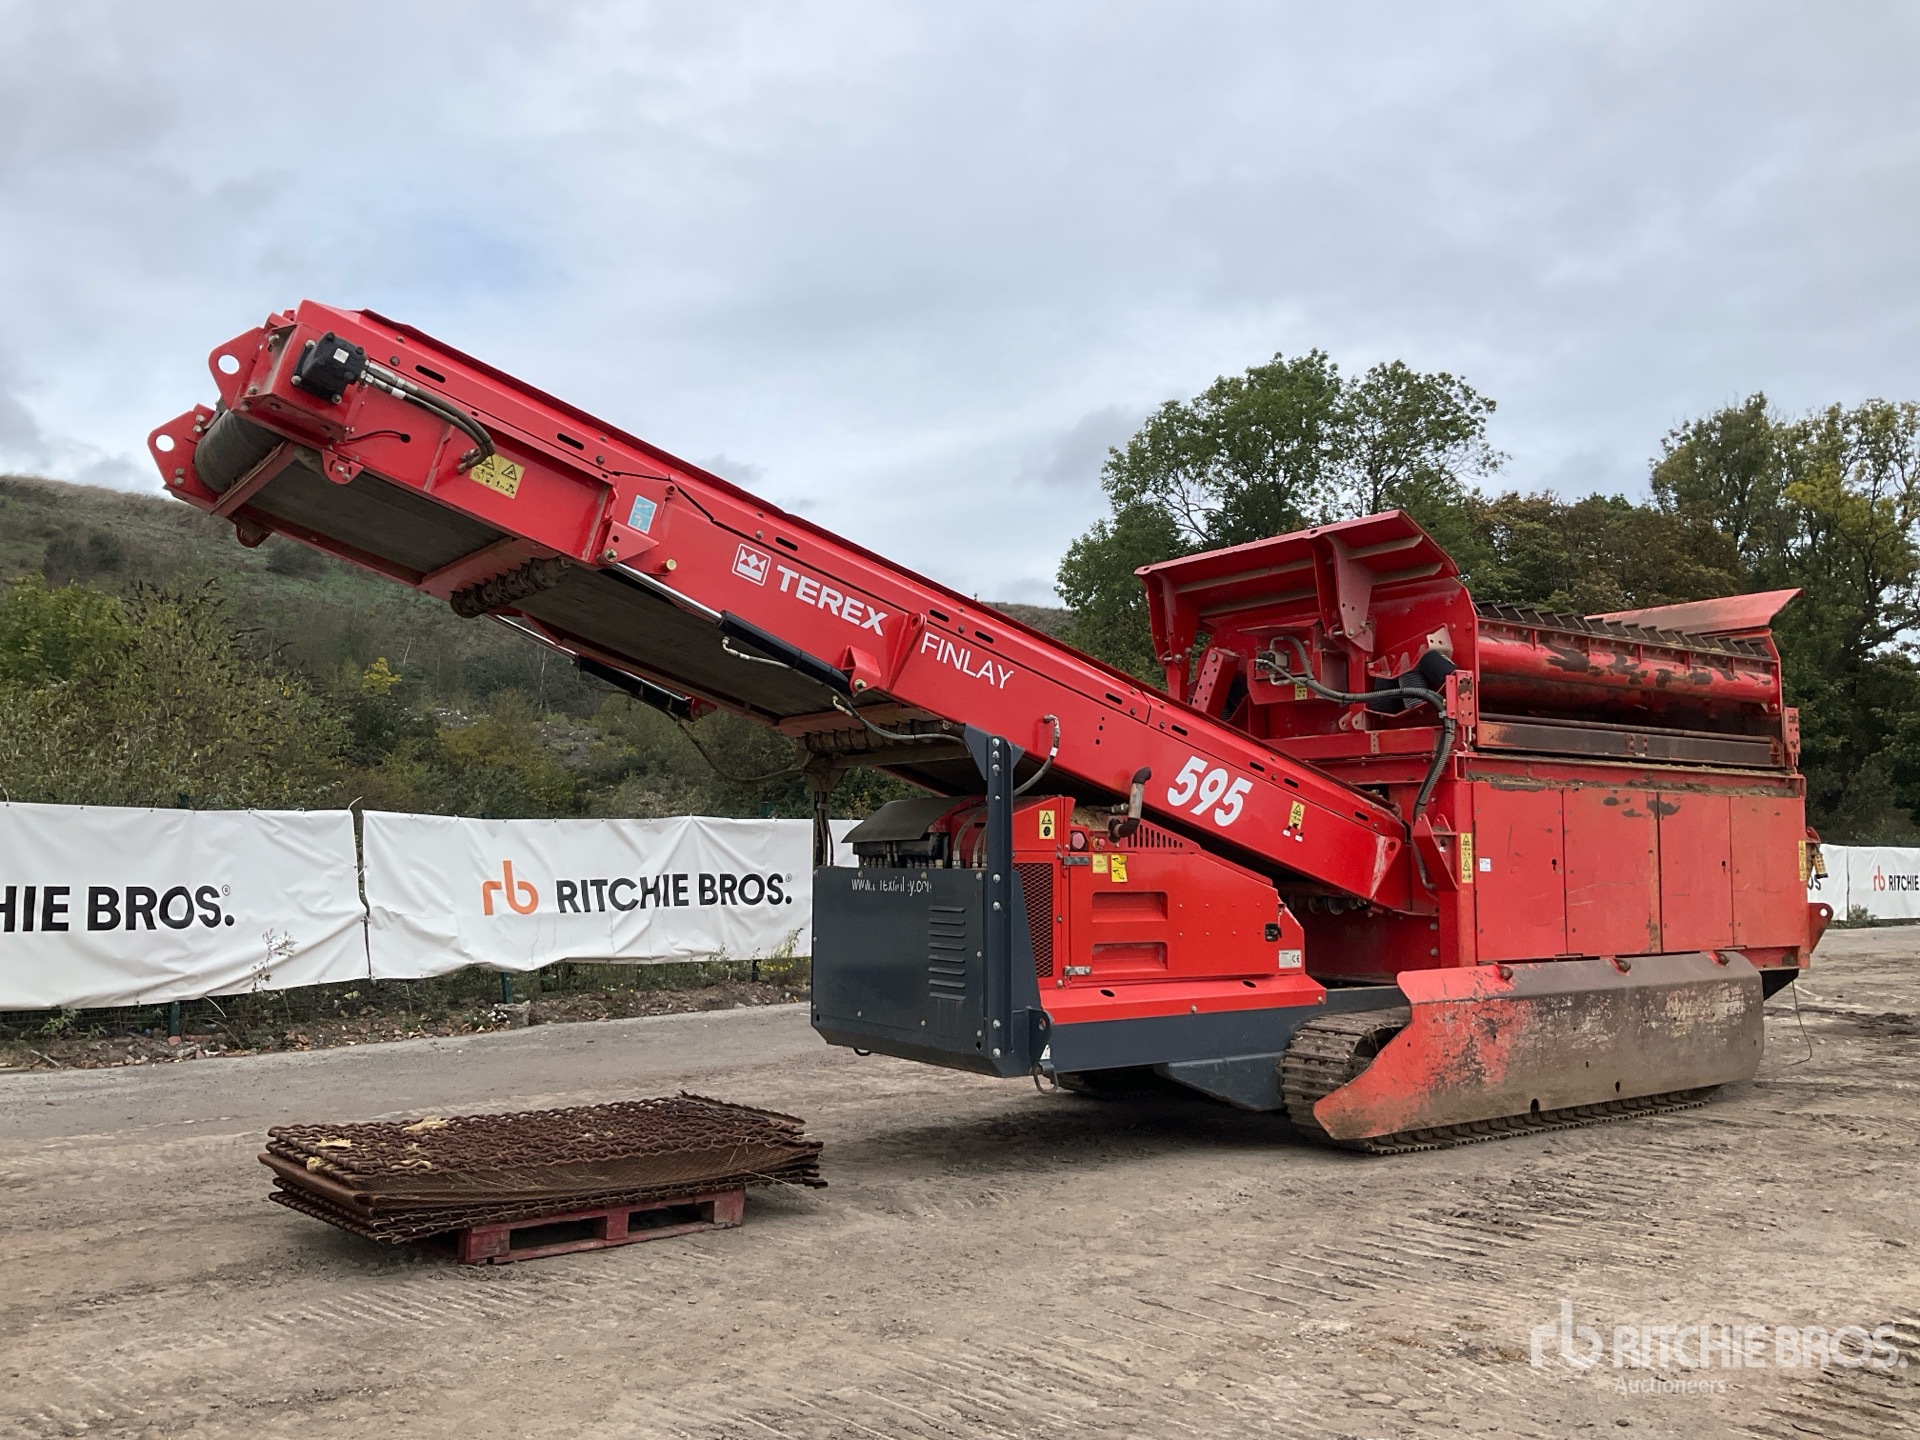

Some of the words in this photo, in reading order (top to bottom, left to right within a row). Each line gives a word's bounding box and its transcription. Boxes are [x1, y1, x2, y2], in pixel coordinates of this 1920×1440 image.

[776, 564, 888, 637] TEREX
[919, 631, 1014, 690] FINLAY
[1167, 755, 1253, 827] 595
[556, 873, 689, 913] RITCHIE
[1888, 874, 1920, 891] RITCHIE
